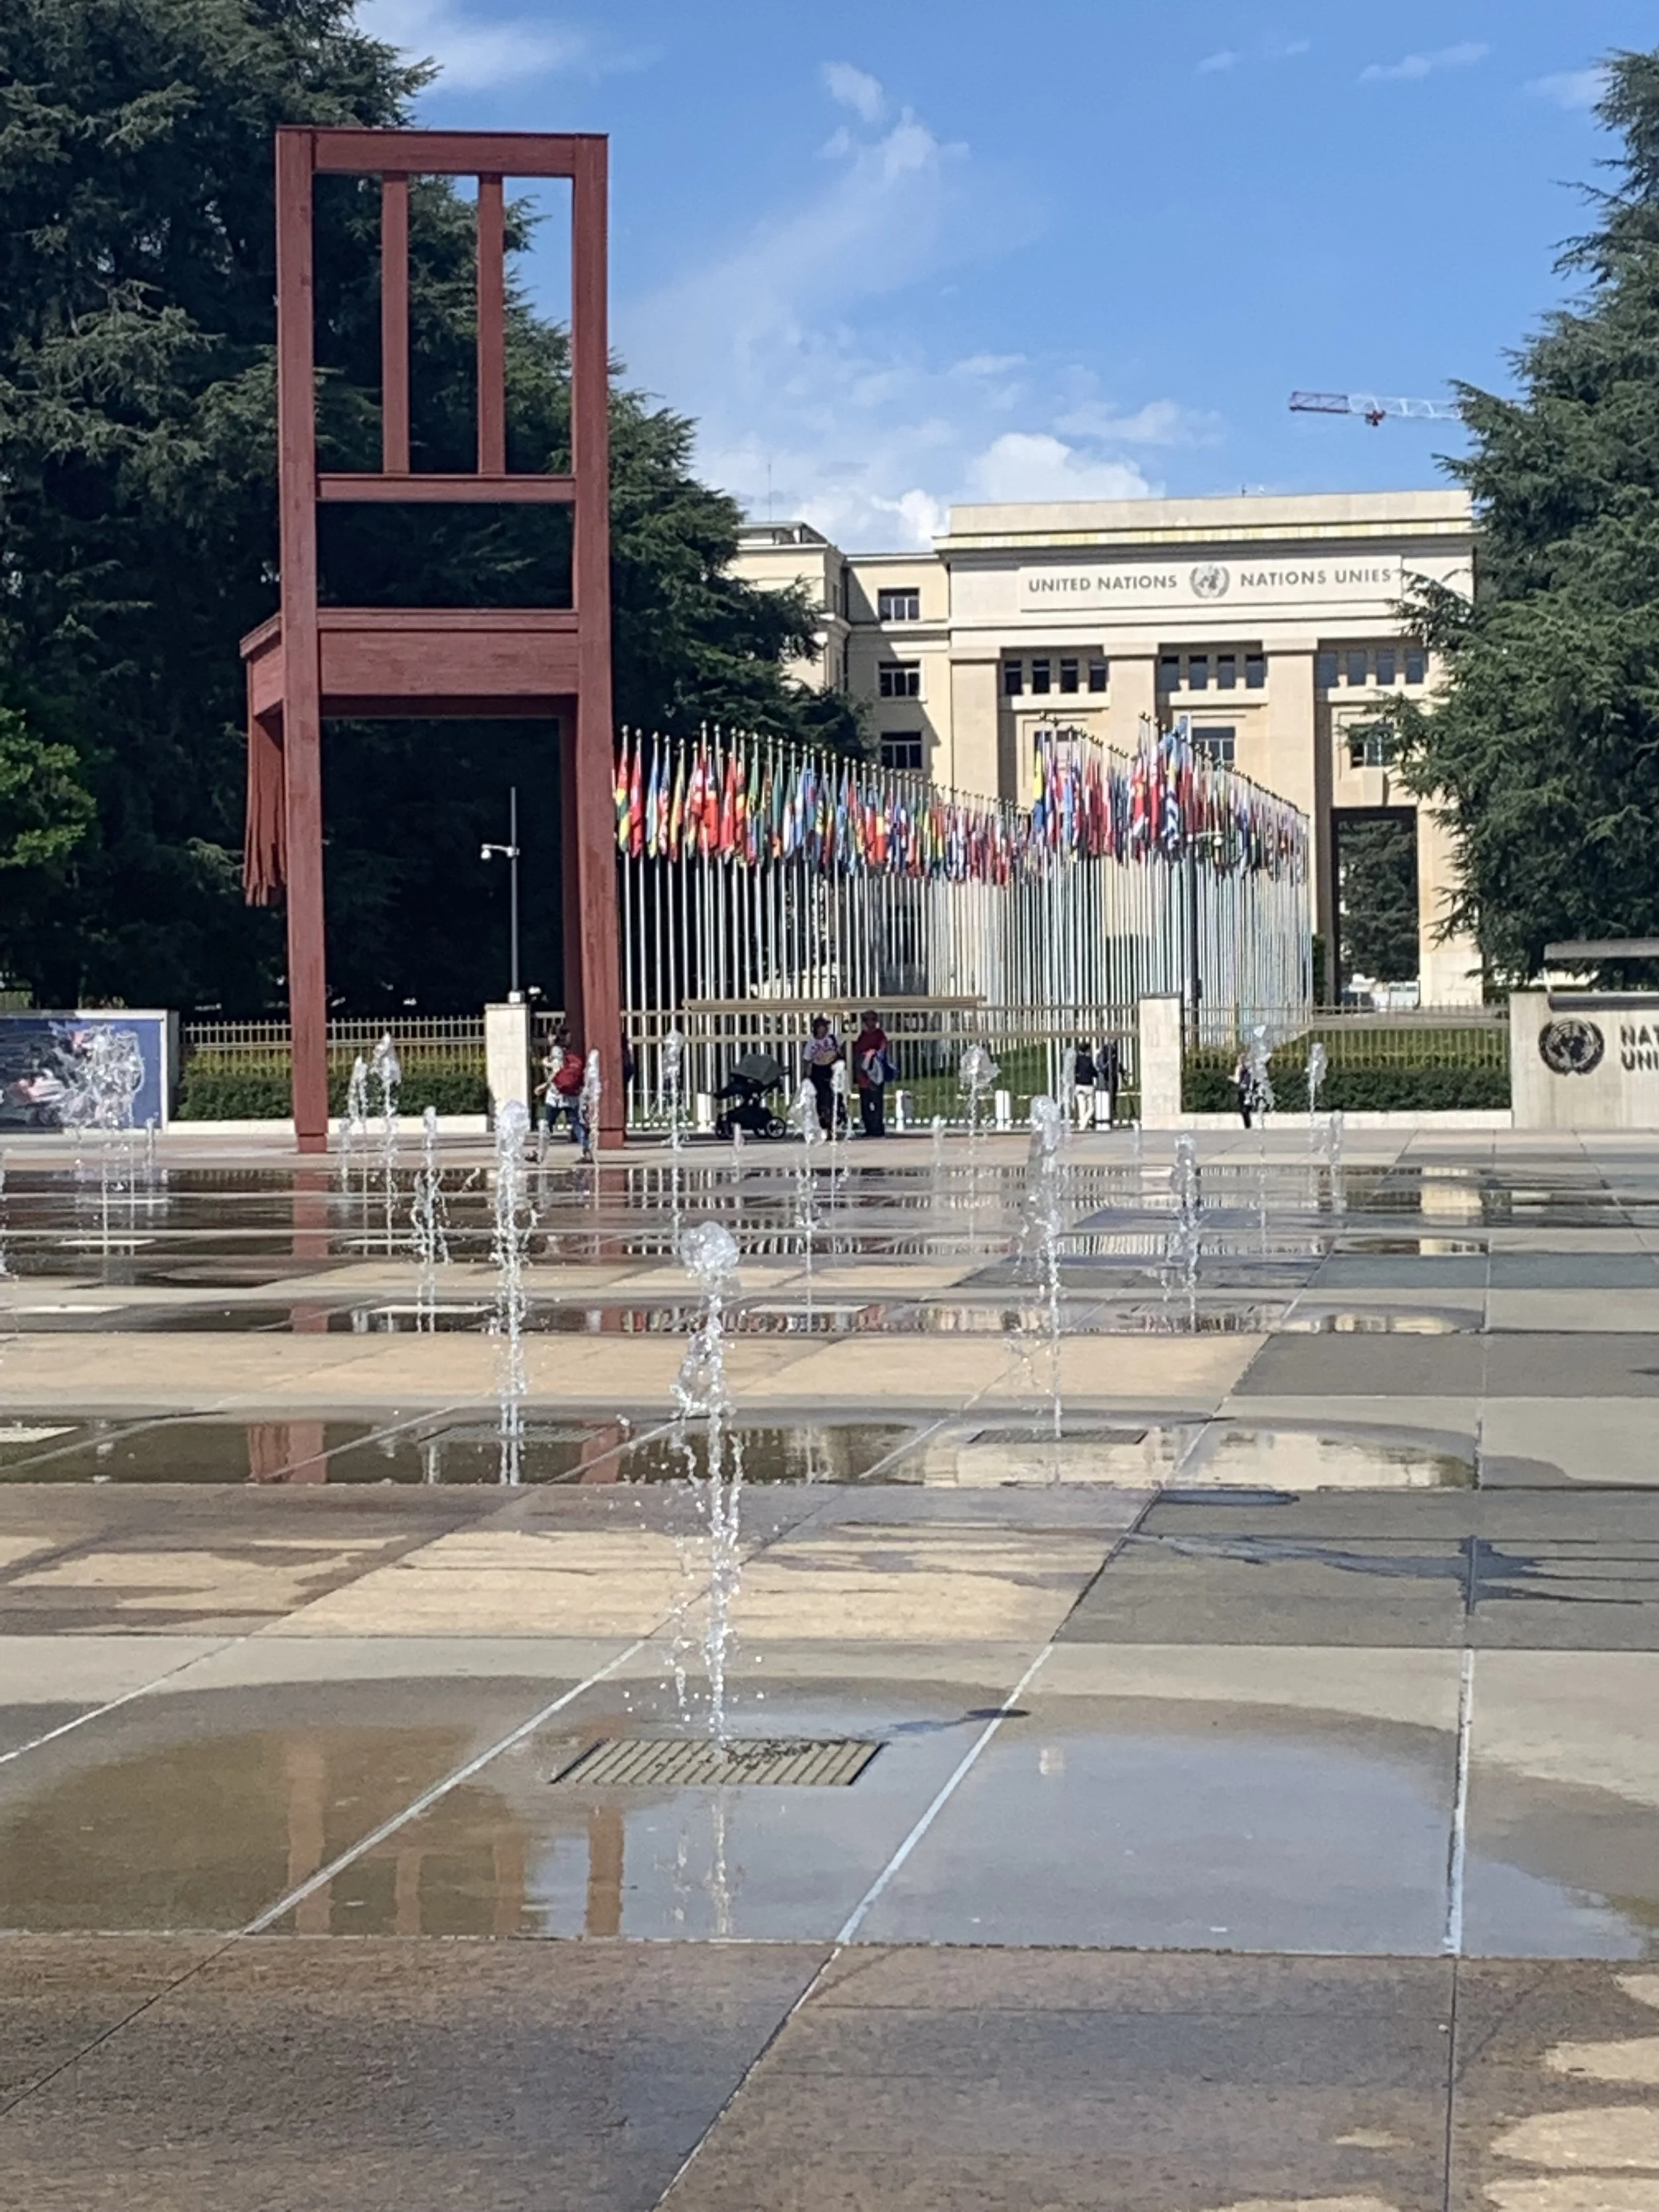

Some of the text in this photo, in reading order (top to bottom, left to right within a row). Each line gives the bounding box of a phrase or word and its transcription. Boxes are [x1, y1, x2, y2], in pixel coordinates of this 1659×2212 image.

[1029, 575, 1177, 592] UNITED NATIONS
[1240, 569, 1392, 587] NATIONS UNIES
[1621, 1049, 1659, 1071] UNI
